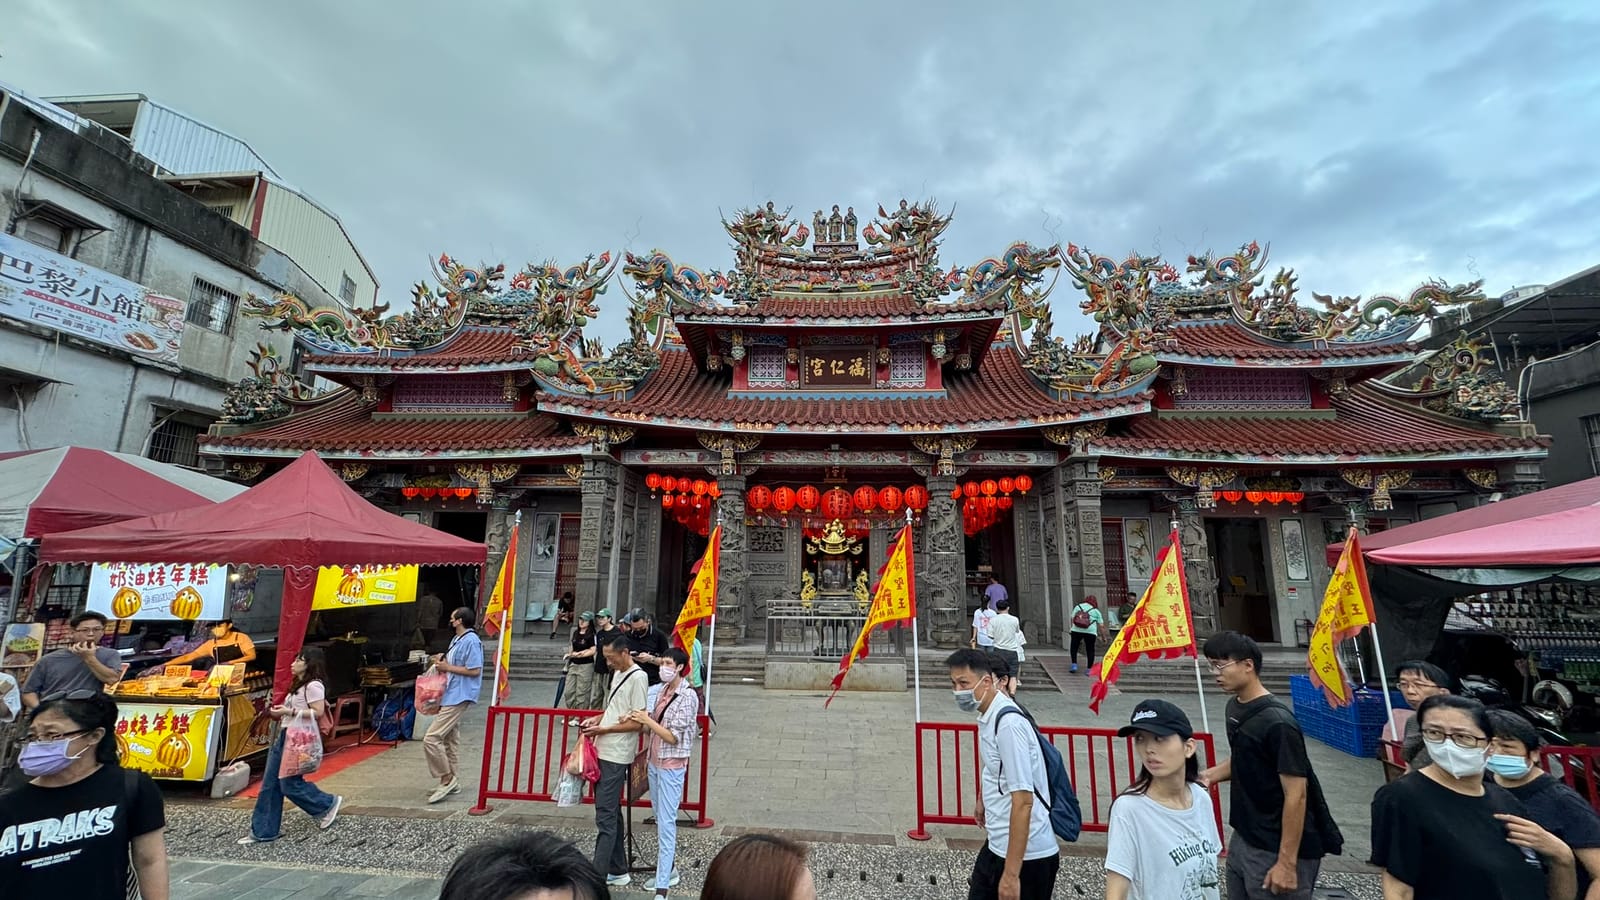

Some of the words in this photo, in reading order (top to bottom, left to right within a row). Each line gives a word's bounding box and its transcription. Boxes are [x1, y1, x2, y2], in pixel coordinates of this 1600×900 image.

[0, 253, 145, 322] 巴黎小館
[810, 357, 866, 377] 福仁宮
[109, 564, 209, 588] 奶油烤年糕
[1168, 843, 1203, 867] Hiking
